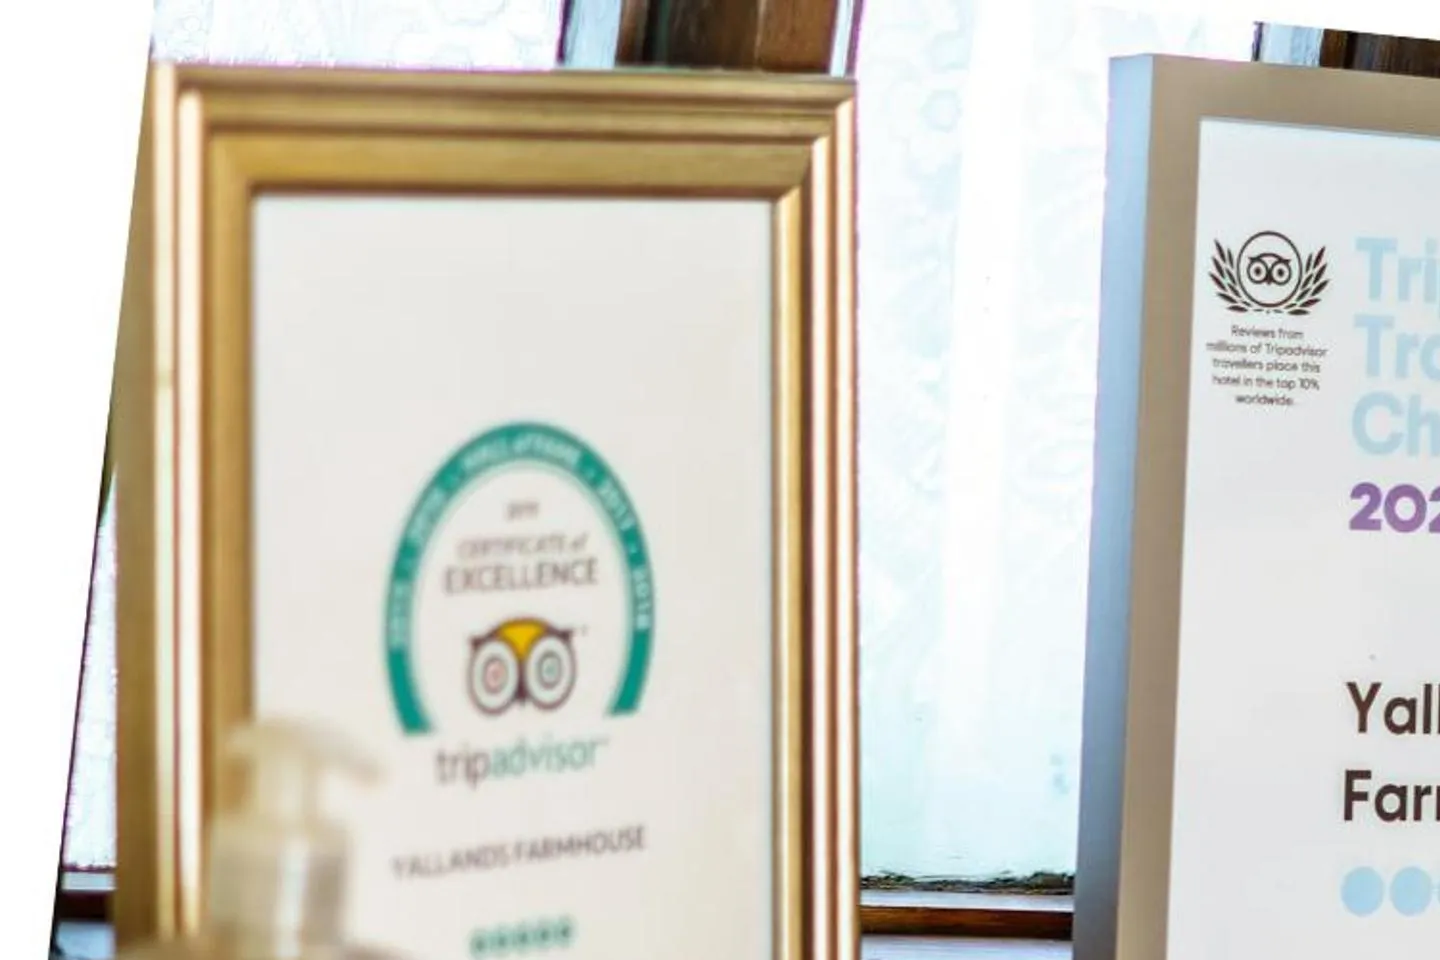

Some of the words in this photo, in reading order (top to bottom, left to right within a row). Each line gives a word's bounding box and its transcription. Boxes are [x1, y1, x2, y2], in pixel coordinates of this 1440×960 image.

[1231, 325, 1276, 338] Reviews
[1278, 328, 1304, 339] from
[1249, 342, 1262, 354] of
[1264, 343, 1328, 357] Tripadvisor
[1212, 358, 1264, 370] travellers
[1265, 360, 1299, 372] place
[1301, 362, 1321, 373] this
[1212, 374, 1241, 386] hotel
[1243, 375, 1253, 386] in
[1255, 376, 1273, 387] the
[1276, 377, 1296, 391] top
[1299, 377, 1320, 390] 10%
[456, 534, 568, 562] CERTIFICATE
[444, 557, 599, 596] EXCELLENCE
[434, 736, 602, 790] tripadvisor
[390, 843, 510, 881] YALLANDS
[514, 824, 647, 864] FARMHOUSE
